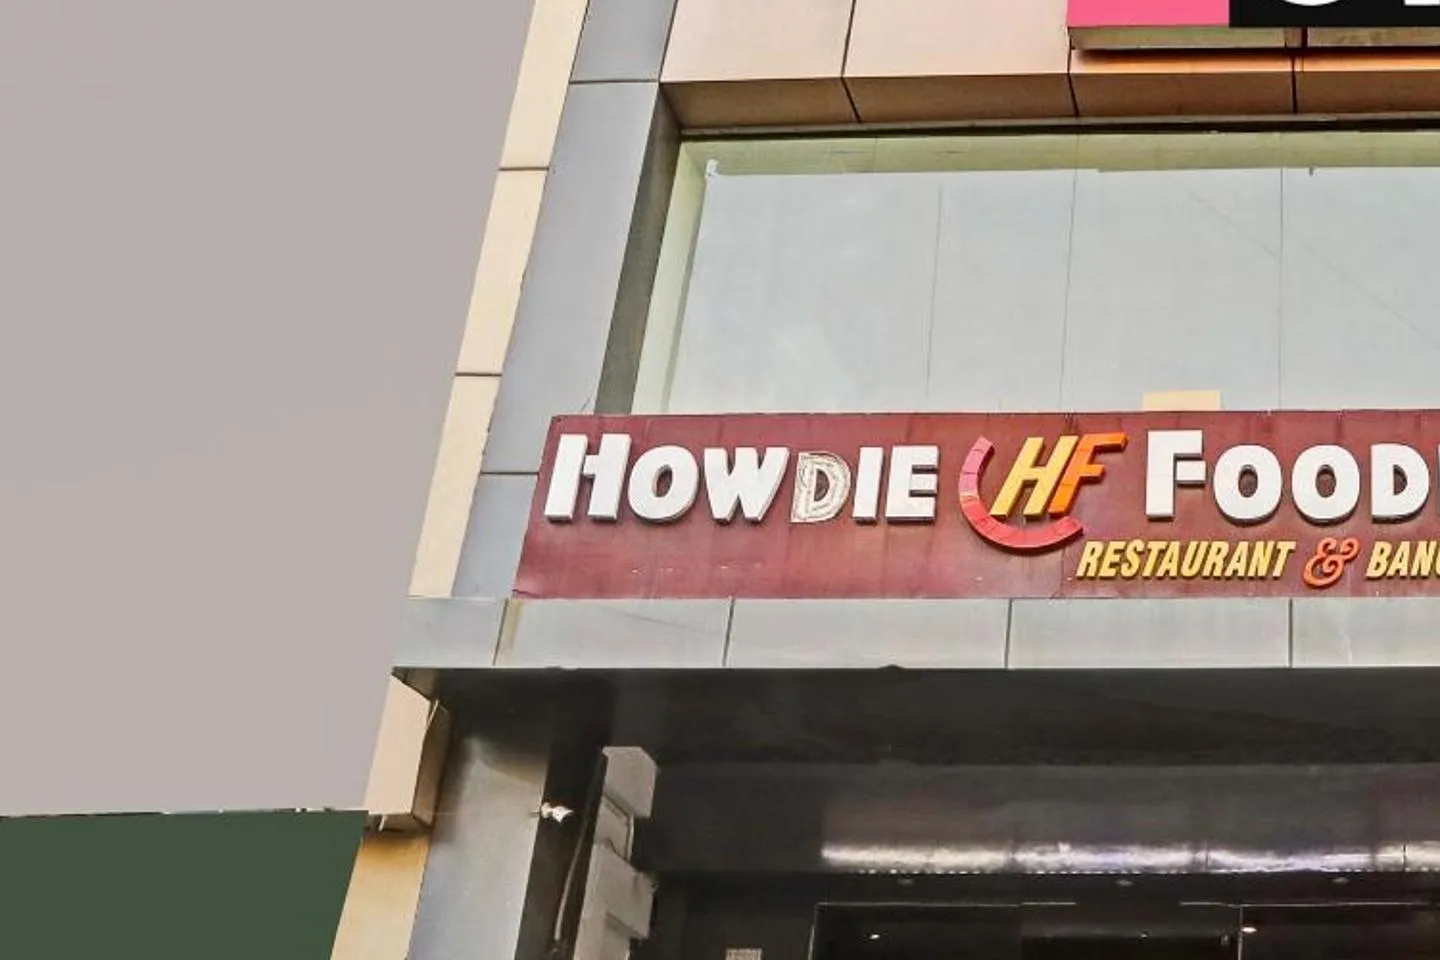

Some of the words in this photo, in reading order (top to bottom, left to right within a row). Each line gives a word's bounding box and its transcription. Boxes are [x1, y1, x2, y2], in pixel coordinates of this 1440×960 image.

[544, 432, 940, 524] HOWDIE
[990, 431, 1128, 518] HF
[1075, 538, 1297, 581] RESTAURANT
[1303, 537, 1360, 588] &
